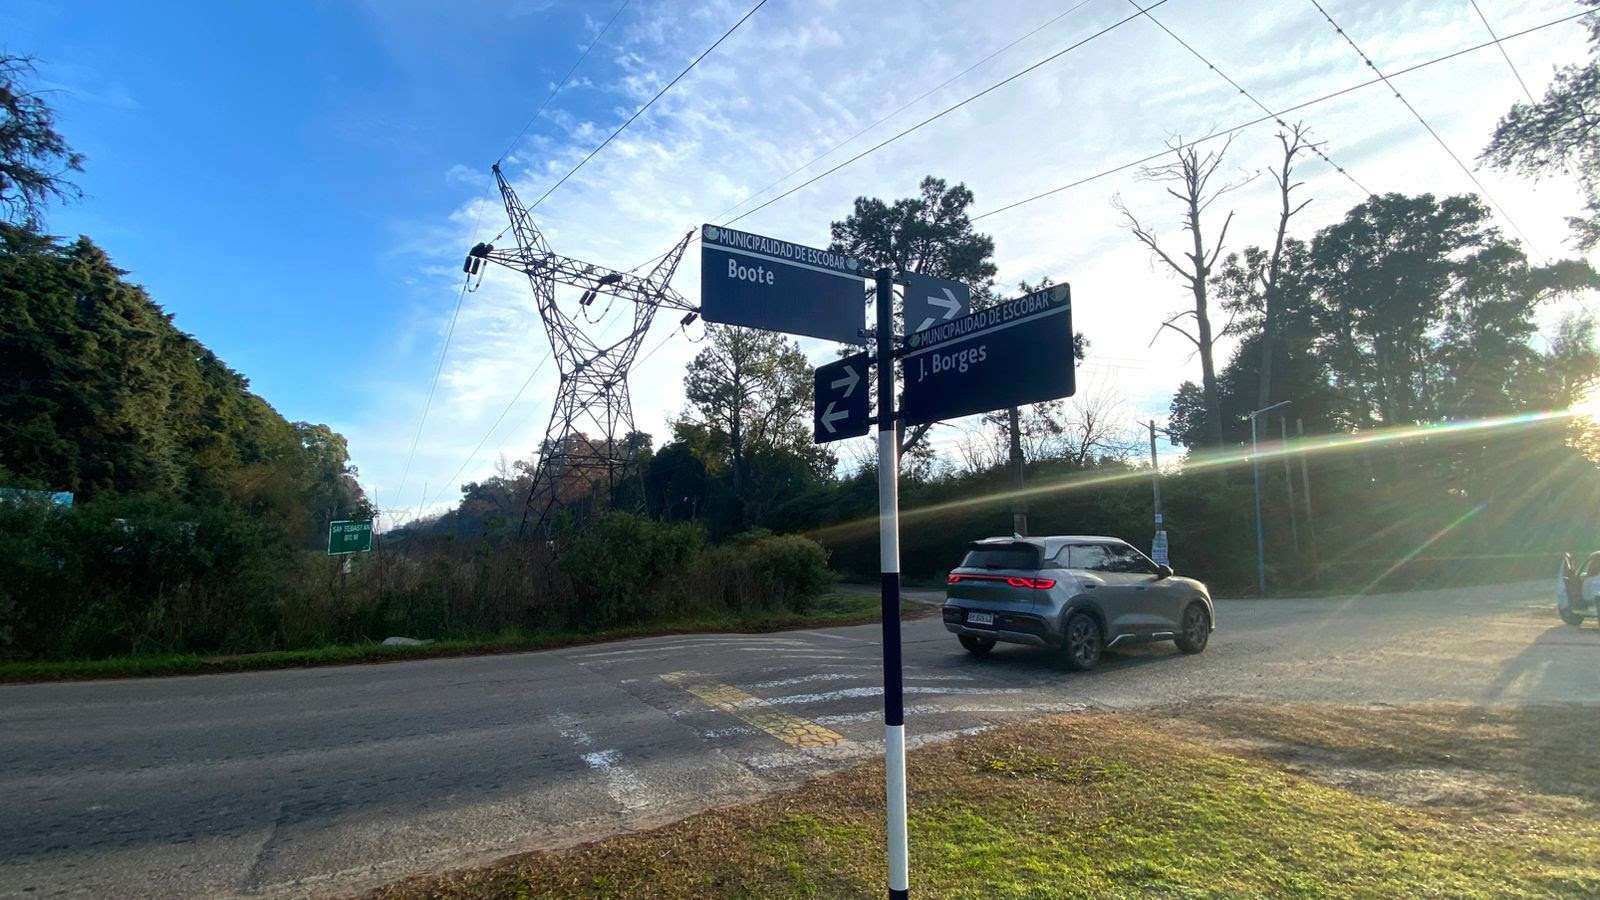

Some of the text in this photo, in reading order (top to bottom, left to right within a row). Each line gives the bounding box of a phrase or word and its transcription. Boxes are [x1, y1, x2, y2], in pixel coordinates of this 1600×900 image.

[719, 228, 846, 270] MUNICIPALIDAD DE ESCOBAR
[728, 259, 775, 285] Boote
[921, 292, 1049, 346] MUNICIPALIDAD DE ESCOBAR
[918, 345, 987, 382] J. Borges
